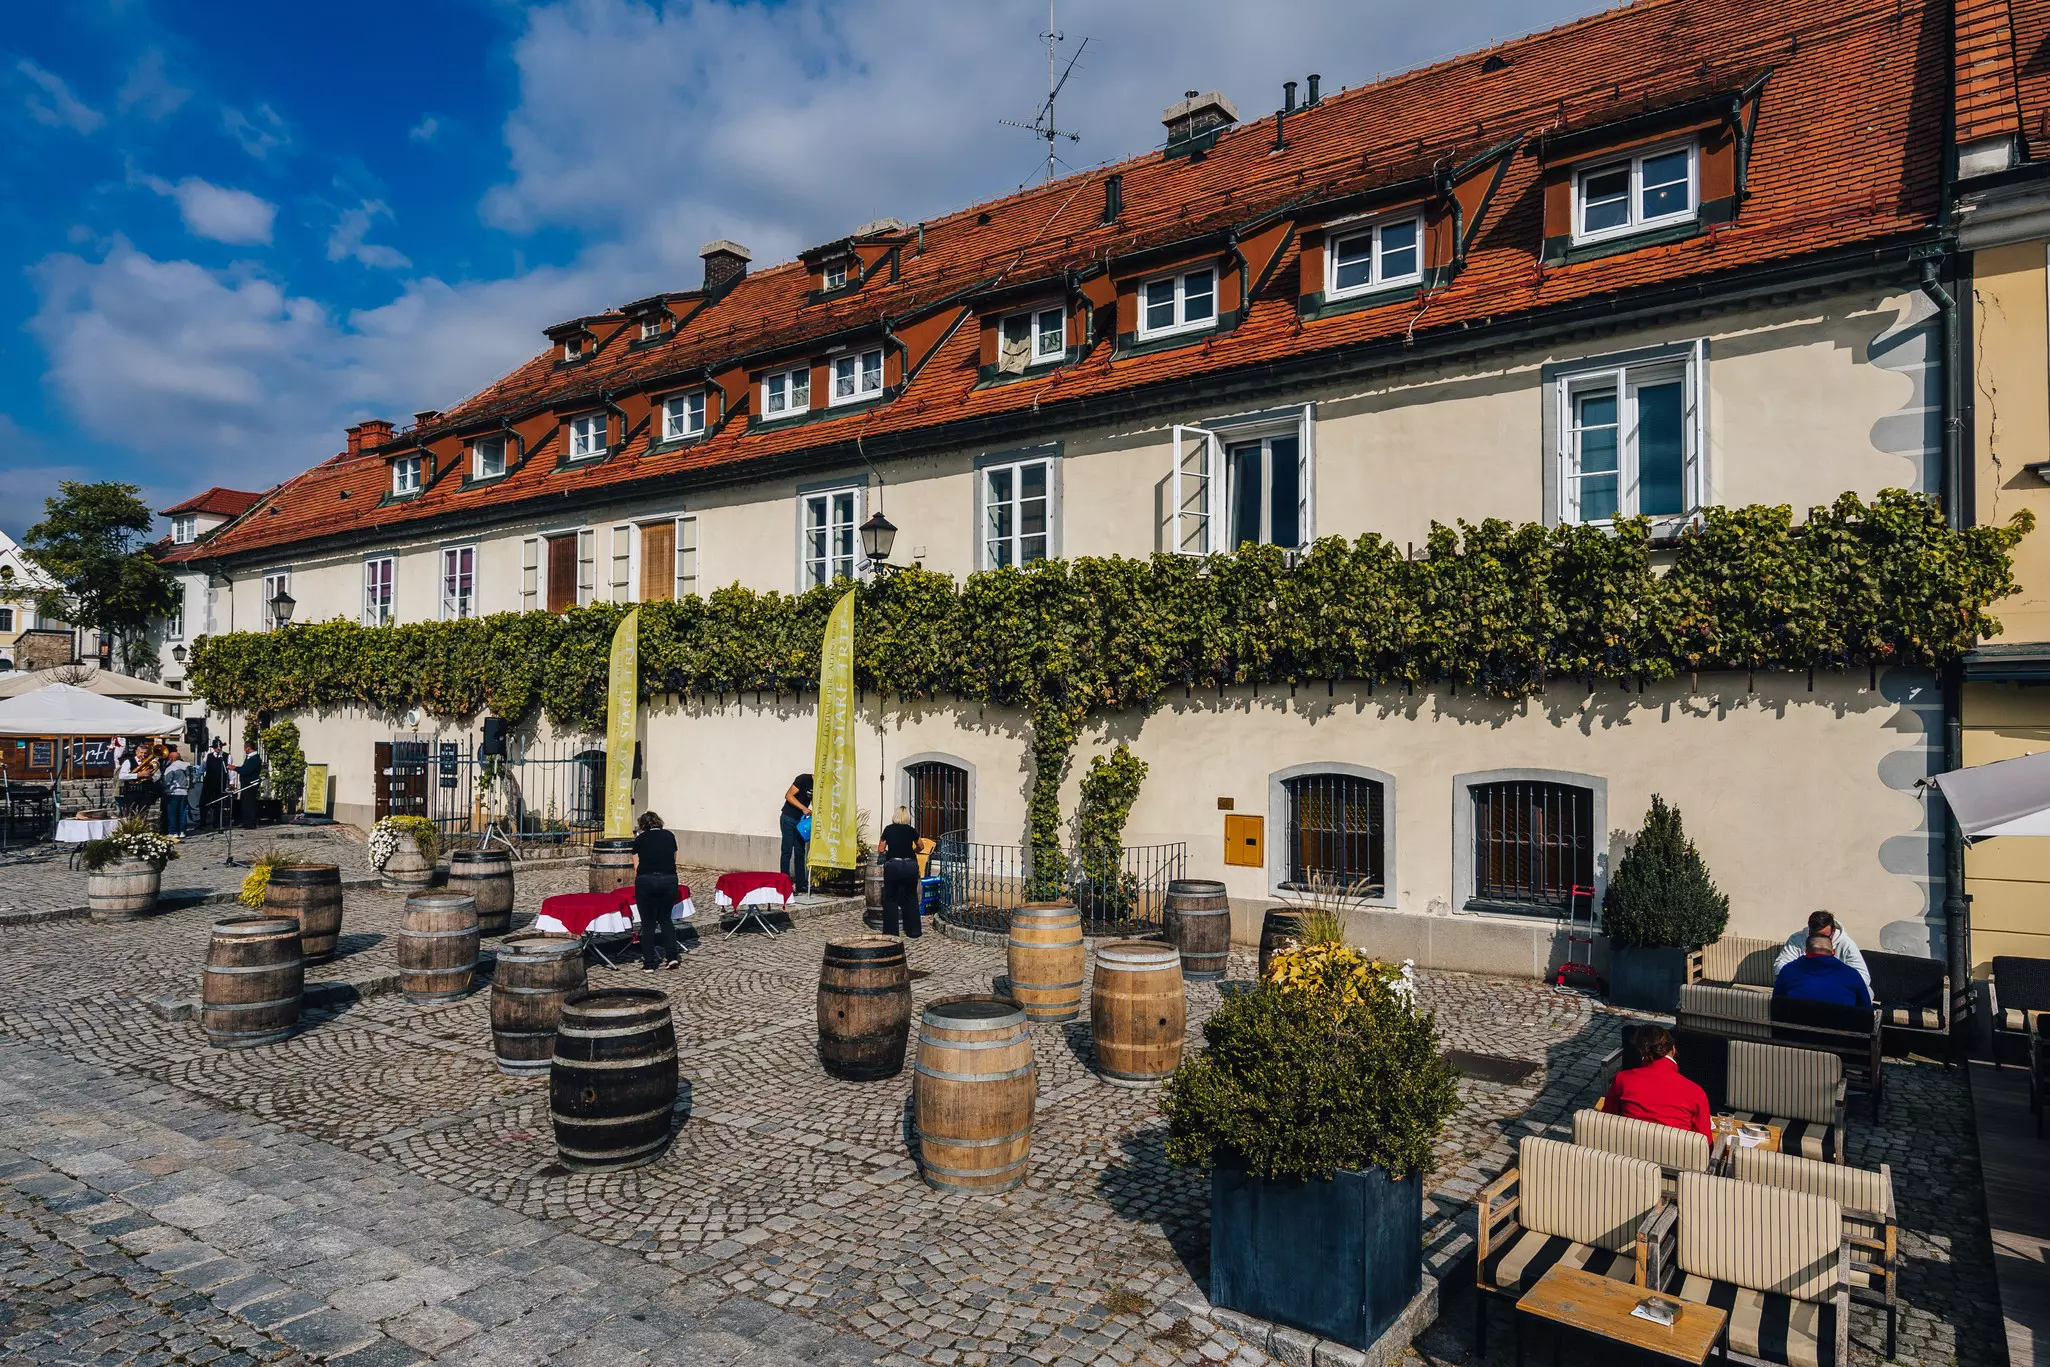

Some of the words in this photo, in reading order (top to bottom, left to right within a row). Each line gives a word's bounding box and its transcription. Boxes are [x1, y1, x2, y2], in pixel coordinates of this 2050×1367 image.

[624, 633, 634, 675] TRTE
[837, 618, 849, 673] TRTE
[620, 685, 632, 739] STARE
[832, 682, 847, 746] STARE
[615, 744, 629, 820] FESTIVAL
[827, 754, 844, 845] FESTIVAL
